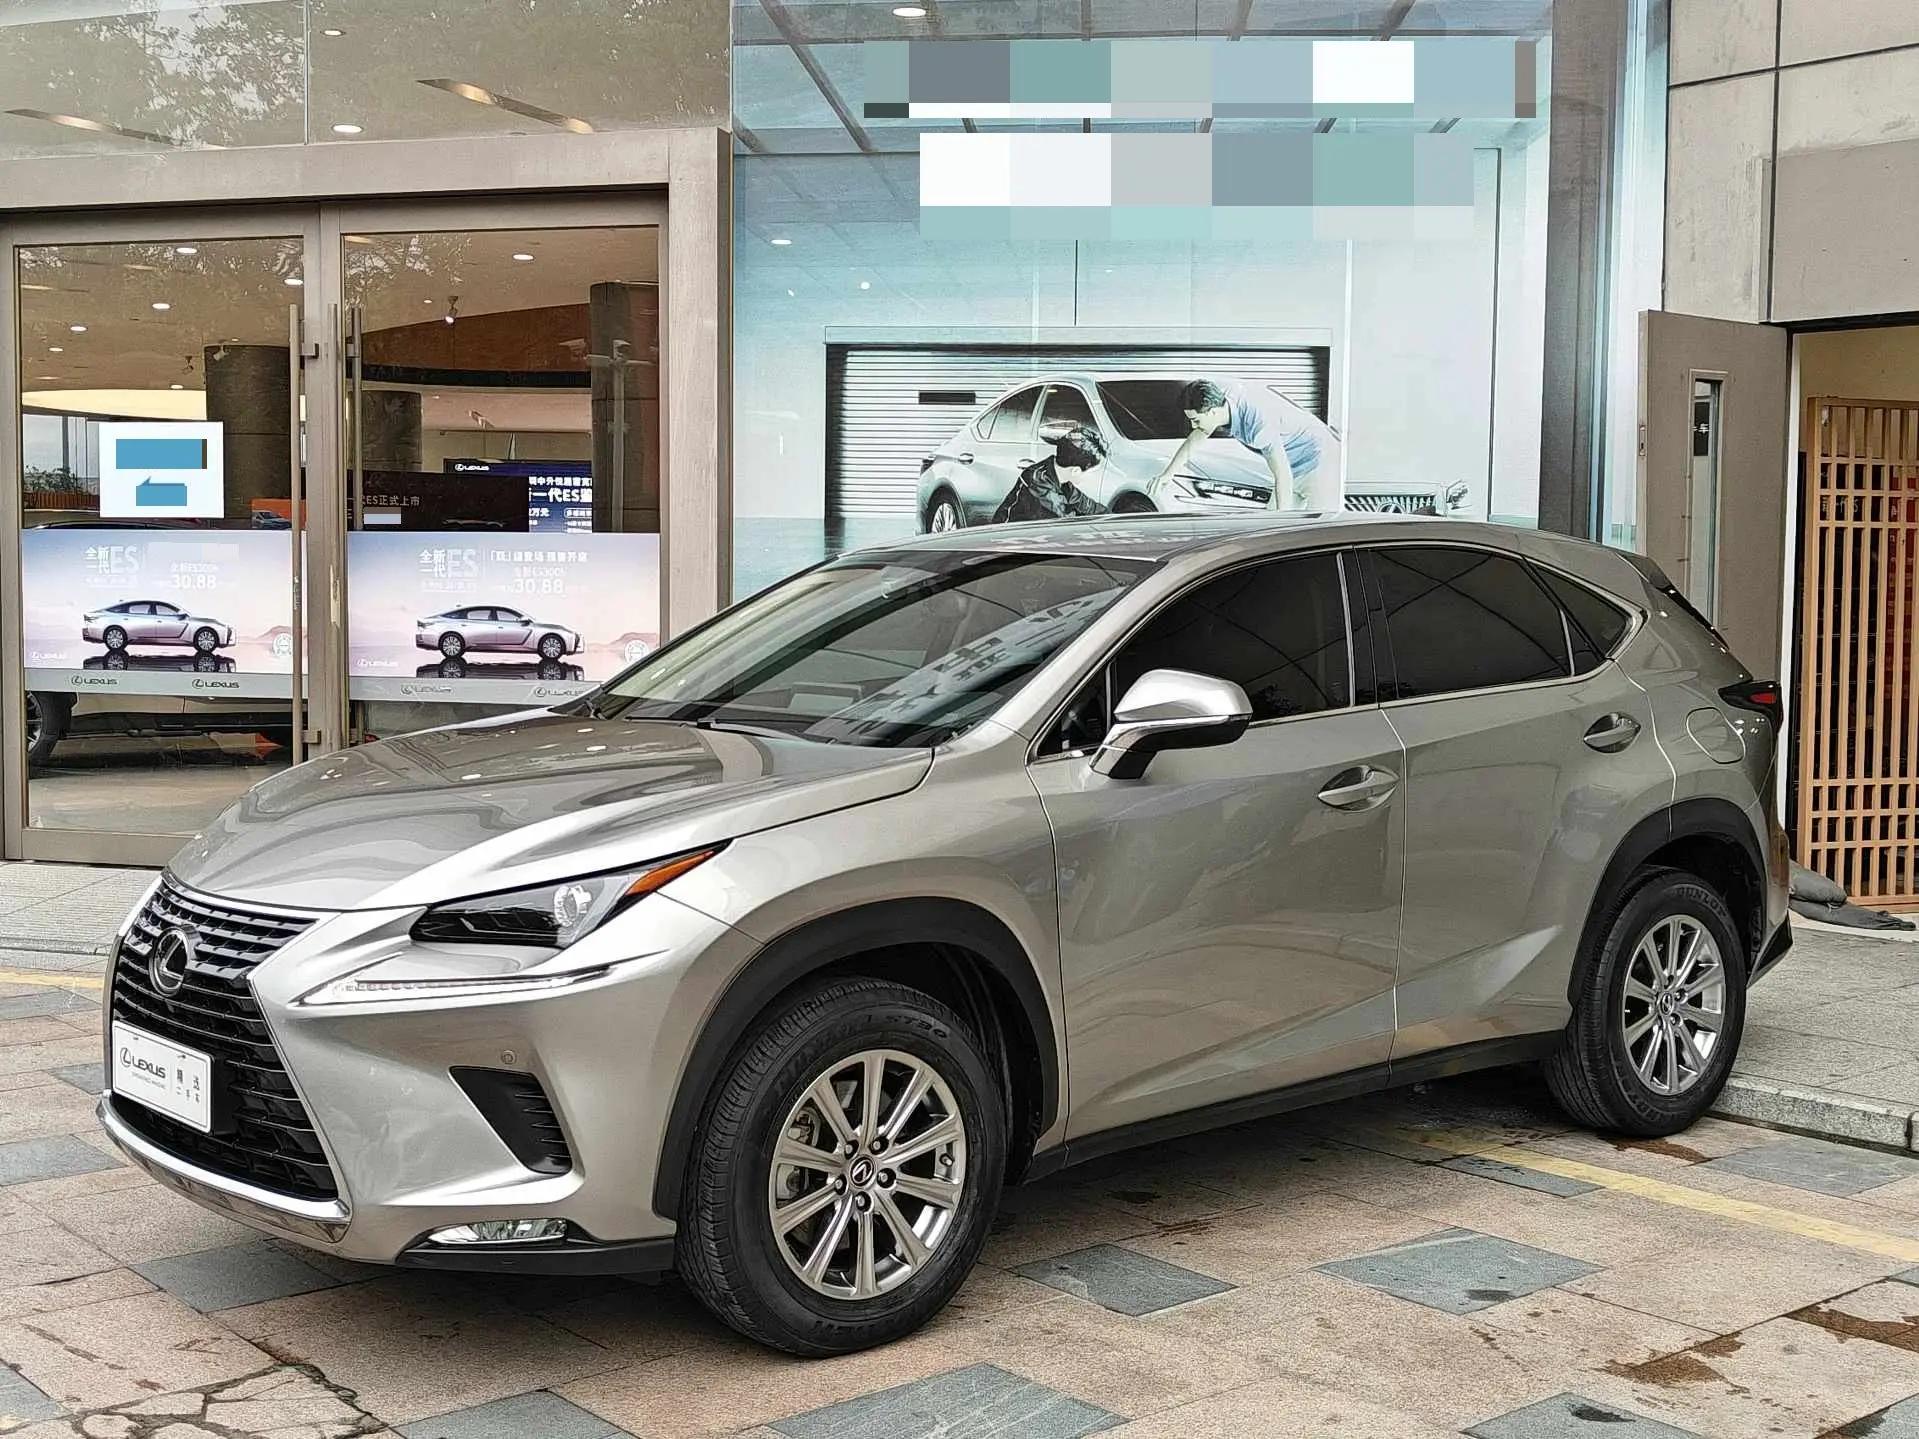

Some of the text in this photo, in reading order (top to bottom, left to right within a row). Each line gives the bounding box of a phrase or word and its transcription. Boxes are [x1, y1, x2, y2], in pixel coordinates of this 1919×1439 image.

[110, 545, 140, 574] ES
[447, 549, 480, 578] ES
[132, 1055, 166, 1079] LEXUS
